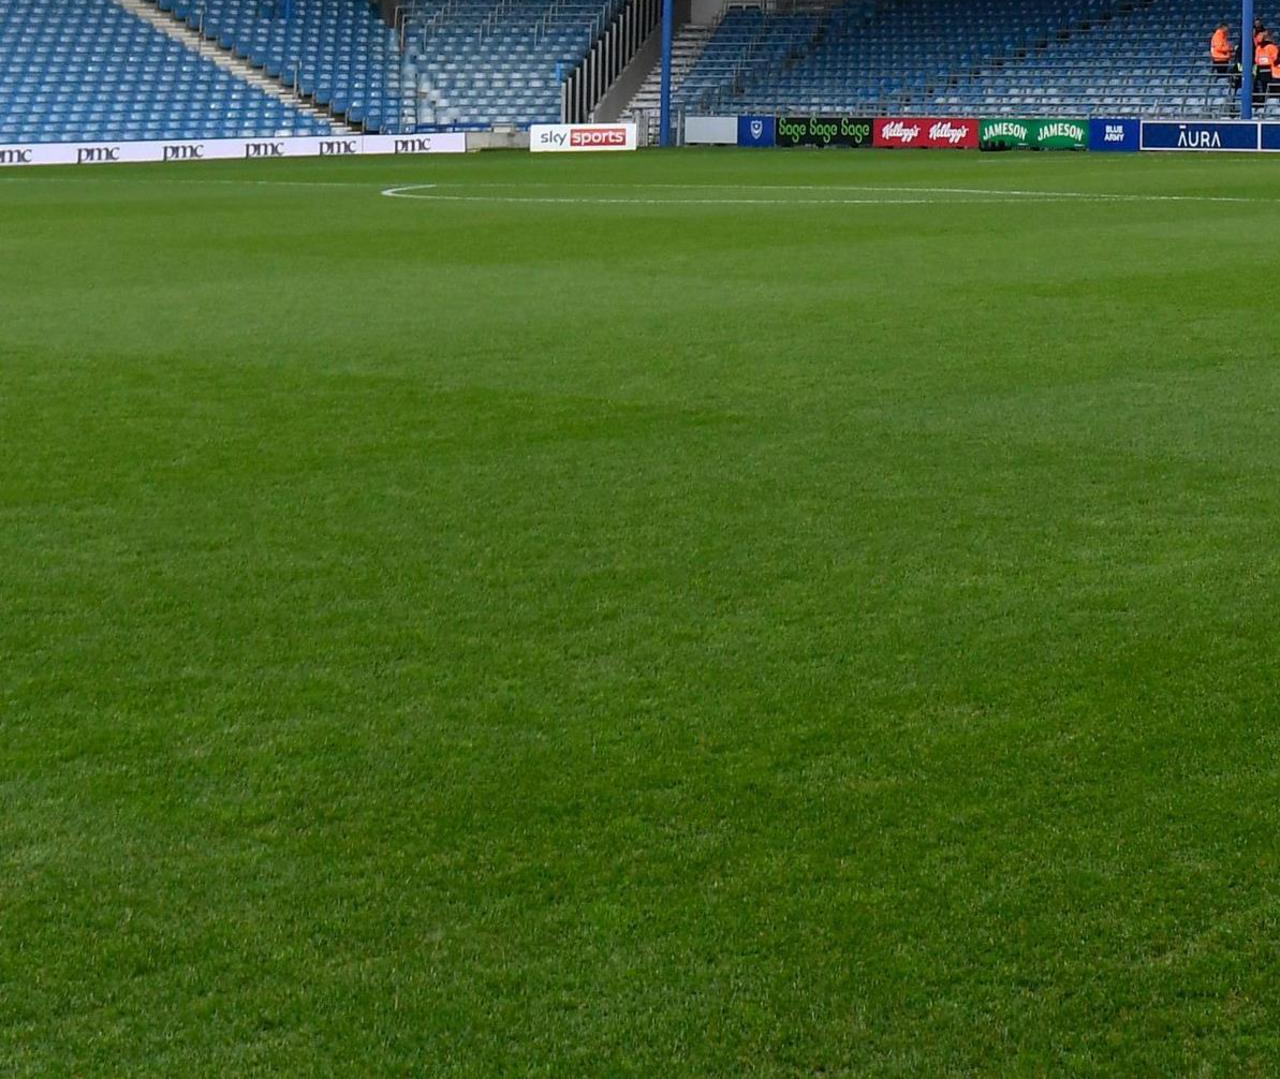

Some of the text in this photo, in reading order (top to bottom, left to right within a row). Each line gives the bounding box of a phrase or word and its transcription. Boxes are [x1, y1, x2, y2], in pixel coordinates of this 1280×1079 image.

[540, 130, 625, 146] sky sports
[881, 121, 921, 143] Kellogg's
[928, 121, 969, 143] Kellogg's
[983, 124, 1027, 142] JAMESON
[1037, 123, 1083, 142] JAMESON
[1104, 133, 1125, 142] ARMY
[1105, 125, 1123, 133] BLUE
[77, 145, 120, 164] pmc
[162, 143, 204, 162] pmc
[245, 141, 285, 159] pmc
[318, 139, 356, 157] pmc
[394, 137, 431, 155] pmc
